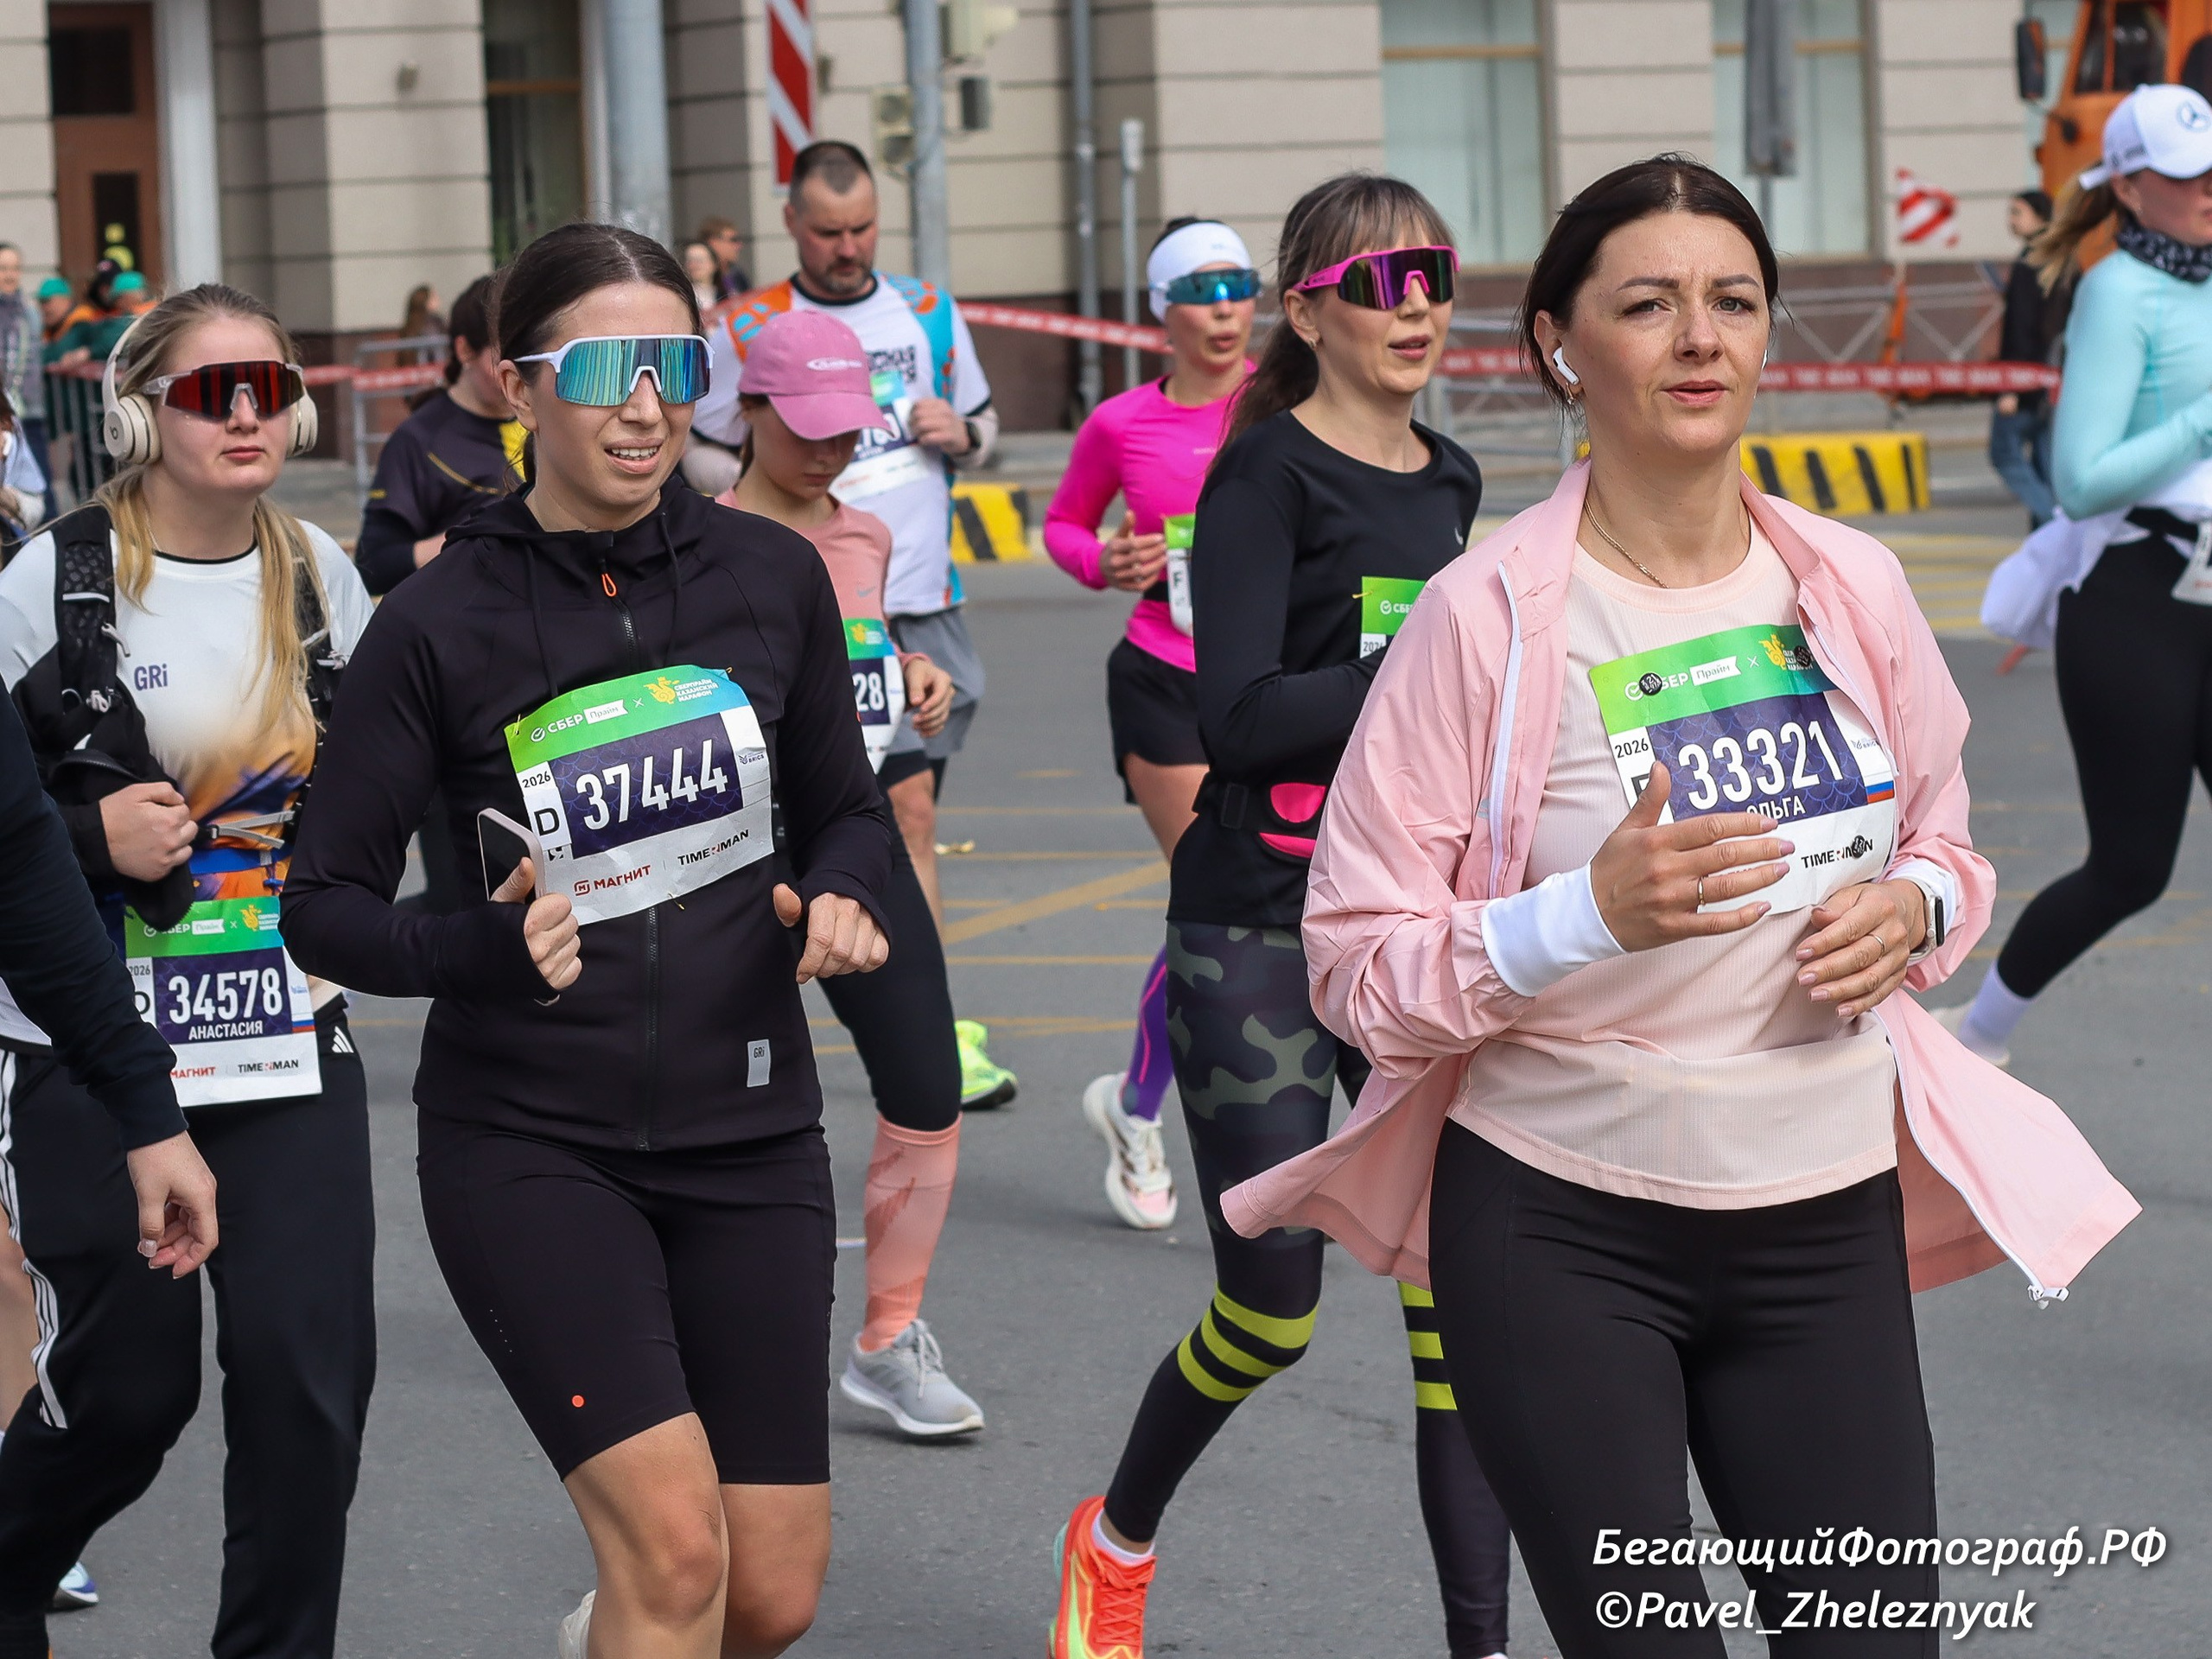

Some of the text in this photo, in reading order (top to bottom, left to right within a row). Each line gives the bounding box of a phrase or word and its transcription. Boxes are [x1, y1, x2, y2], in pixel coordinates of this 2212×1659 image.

[1392, 603, 1414, 613] СБЕ
[134, 664, 168, 691] GRi
[1661, 672, 1689, 690] БЕР
[1696, 664, 1731, 680] Прайм
[852, 671, 885, 711] 28
[547, 705, 619, 734] СБЕР Прайм
[1615, 738, 1649, 759] 2026
[1677, 721, 1844, 810] 33321
[522, 772, 551, 788] 2026
[575, 739, 728, 830] 37444
[534, 807, 560, 836] D
[594, 865, 651, 890] МАГНИТ
[168, 967, 283, 1025] 34578
[188, 1020, 263, 1040] АНАСТАСИЯ
